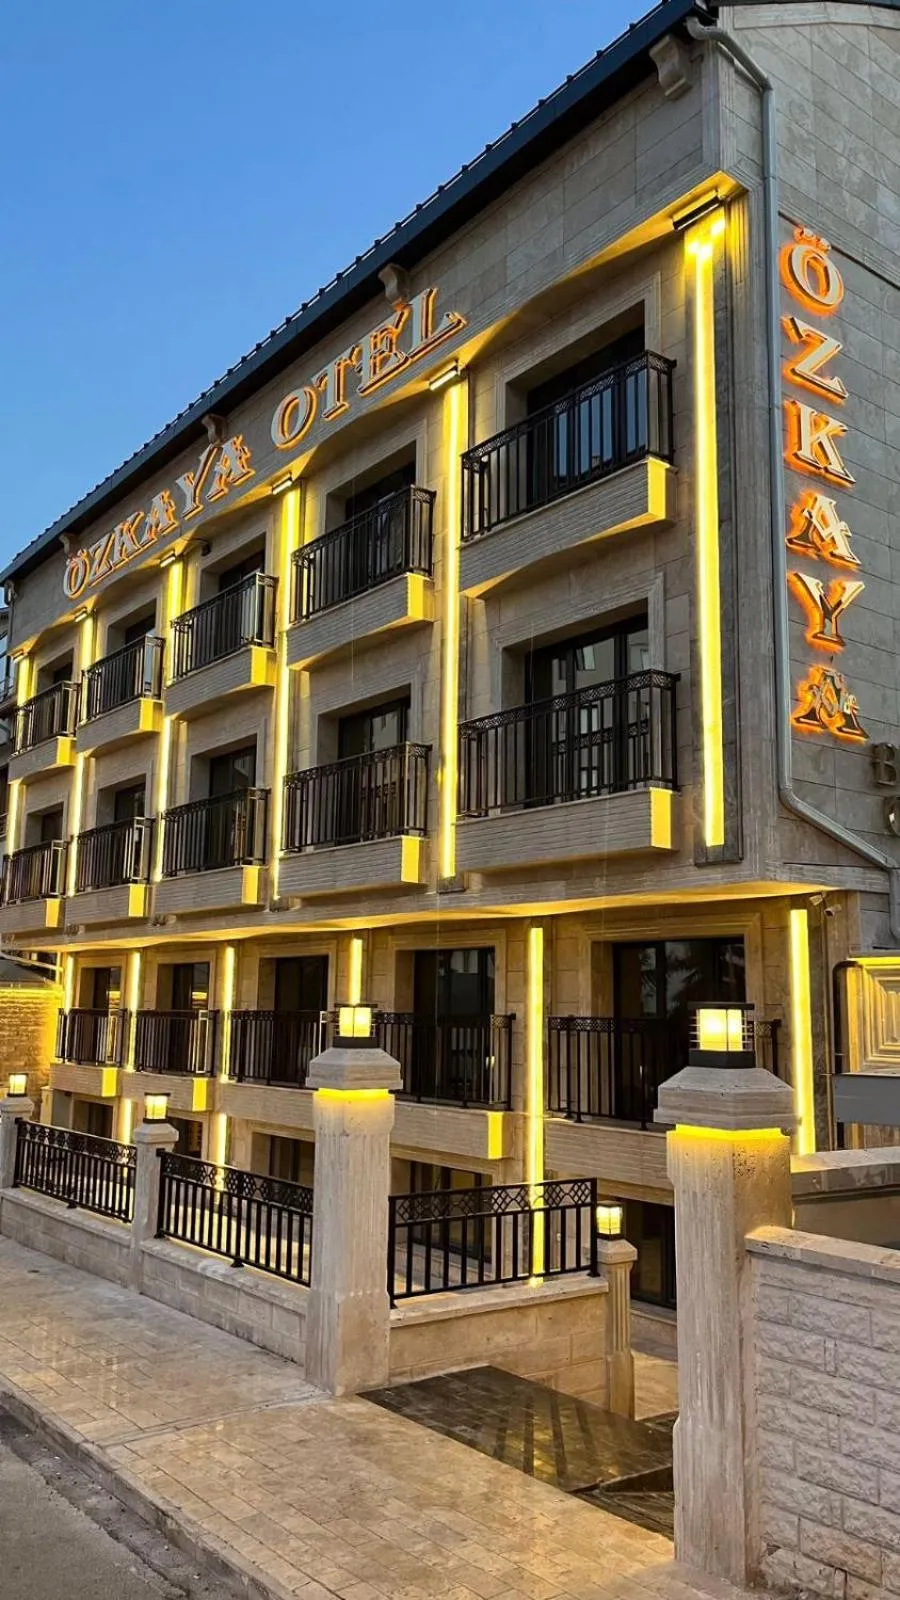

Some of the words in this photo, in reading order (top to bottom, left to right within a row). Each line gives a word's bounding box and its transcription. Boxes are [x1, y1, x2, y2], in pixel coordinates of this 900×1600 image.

[63, 435, 256, 599] ÖZKAYA
[271, 288, 467, 450] OTEL
[779, 227, 869, 741] ÖZKAYA
